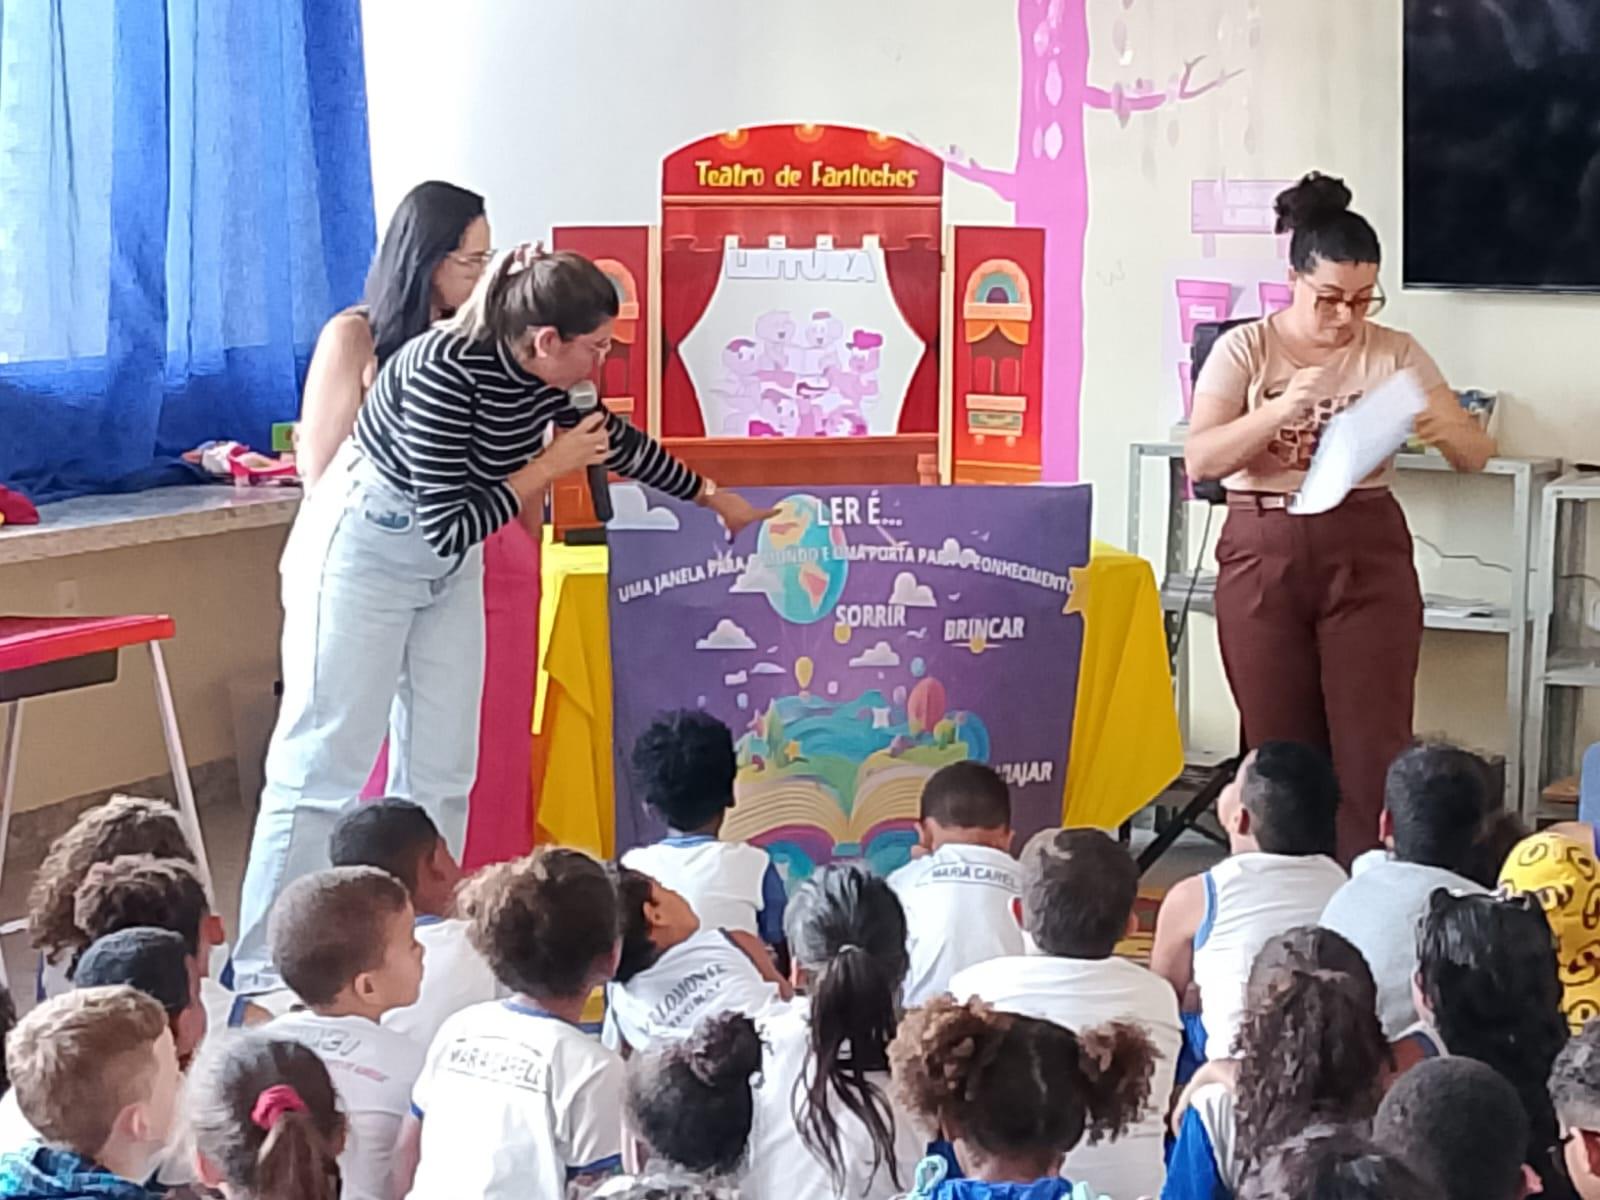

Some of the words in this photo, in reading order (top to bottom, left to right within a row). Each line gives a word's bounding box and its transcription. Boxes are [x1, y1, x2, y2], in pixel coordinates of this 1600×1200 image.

[695, 161, 764, 187] Teatro
[775, 165, 801, 187] de
[812, 161, 919, 188] Fantoches
[817, 497, 861, 526] LER
[617, 582, 651, 603] UMA
[653, 565, 704, 595] JANELA
[707, 556, 745, 578] PARA
[867, 545, 915, 563] PORTA
[835, 604, 907, 628] SORRIR
[944, 617, 1024, 641] BRINCAR
